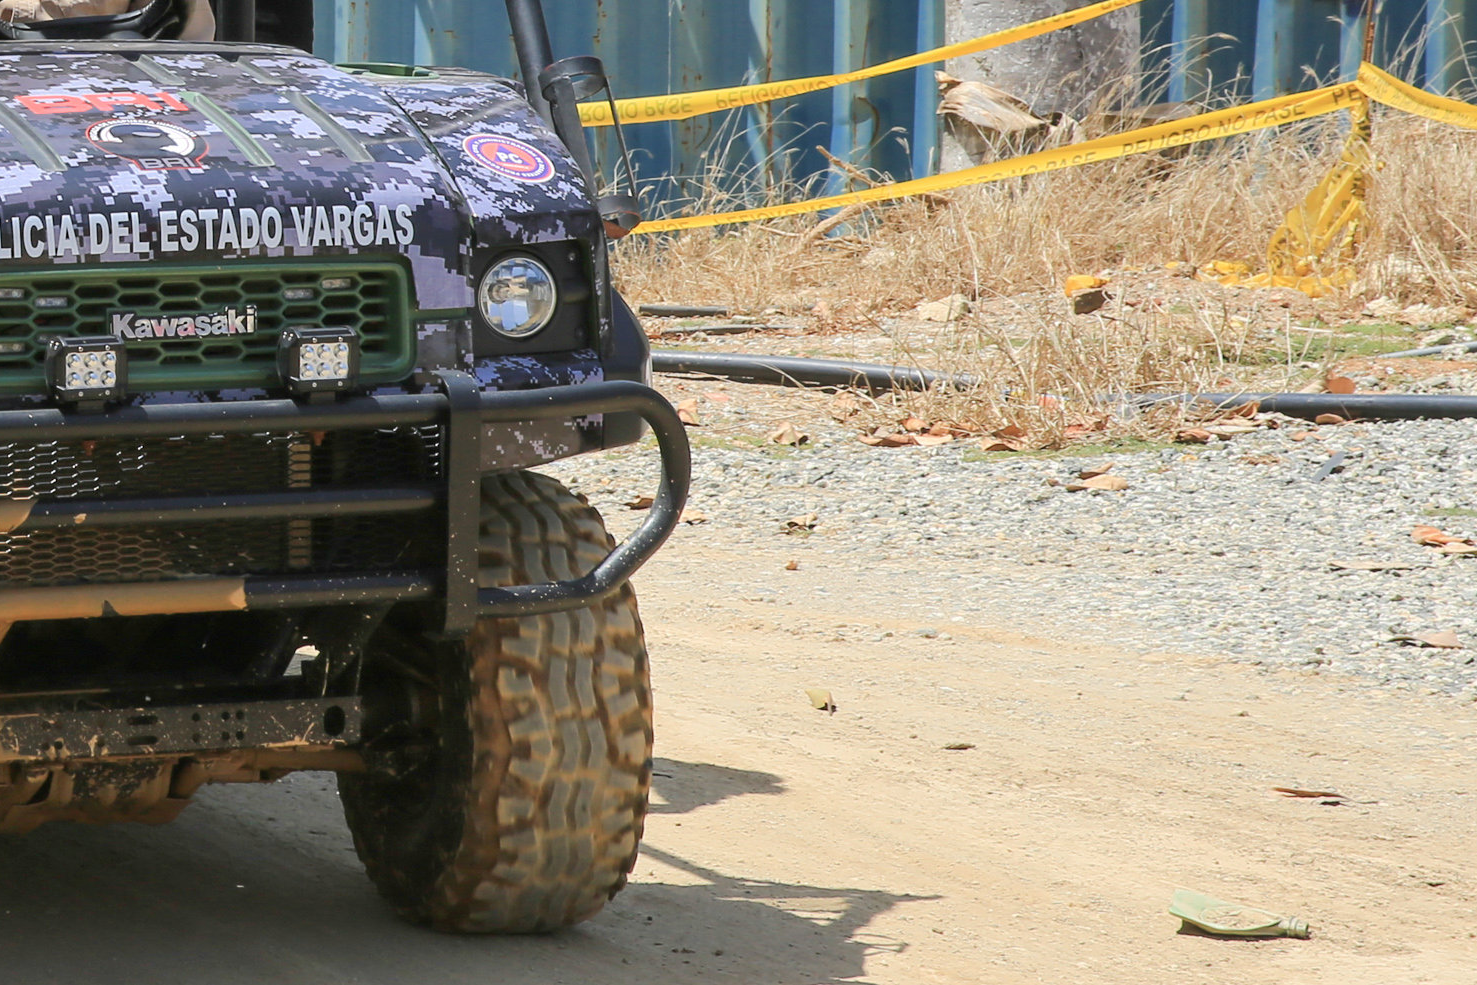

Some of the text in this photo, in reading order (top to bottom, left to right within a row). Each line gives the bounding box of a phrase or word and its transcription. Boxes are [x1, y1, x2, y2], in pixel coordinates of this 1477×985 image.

[14, 91, 189, 114] BRI
[1121, 124, 1212, 155] PELIGRO
[1216, 115, 1243, 134] NO
[1252, 104, 1306, 126] PASE
[138, 157, 196, 170] BRI
[88, 211, 150, 255] DEL
[159, 206, 283, 253] ESTADO
[290, 204, 414, 247] VARGAS
[112, 306, 256, 339] Kawasaki
